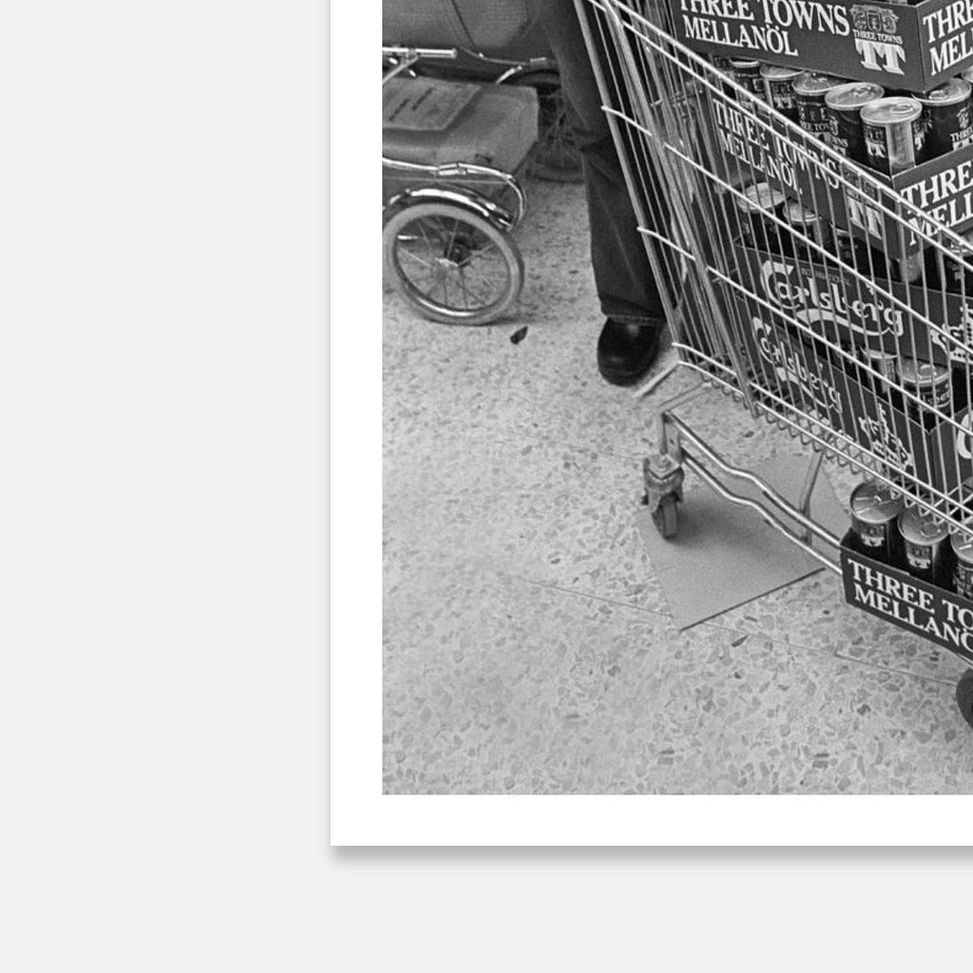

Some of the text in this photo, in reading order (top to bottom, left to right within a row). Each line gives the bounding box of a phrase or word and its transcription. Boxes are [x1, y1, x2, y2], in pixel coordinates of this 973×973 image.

[682, 15, 799, 57] MELLANÖL
[854, 37, 907, 76] TT
[760, 260, 904, 337] Carlsberg
[847, 558, 935, 614] THREE
